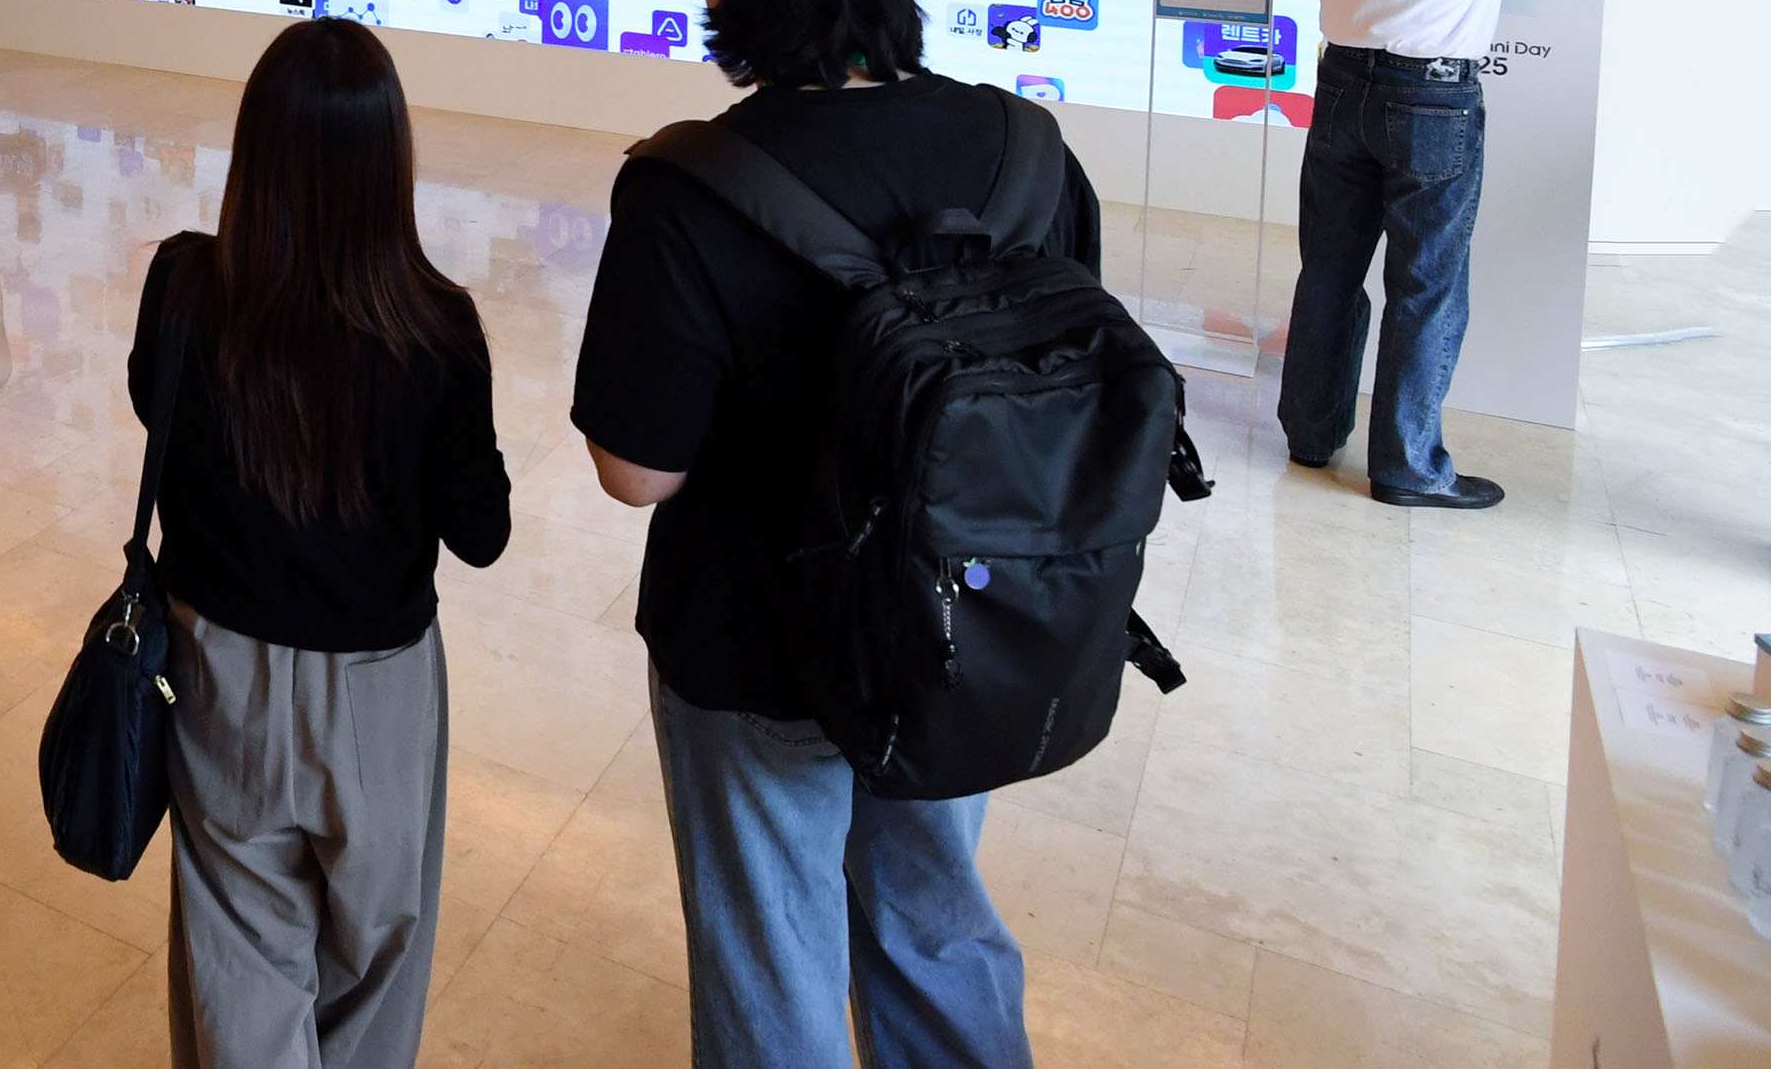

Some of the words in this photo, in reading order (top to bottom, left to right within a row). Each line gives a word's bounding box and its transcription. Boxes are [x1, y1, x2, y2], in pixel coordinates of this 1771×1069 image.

[1045, 2, 1091, 19] 400
[1490, 41, 1509, 53] ni
[1514, 42, 1551, 58] Day
